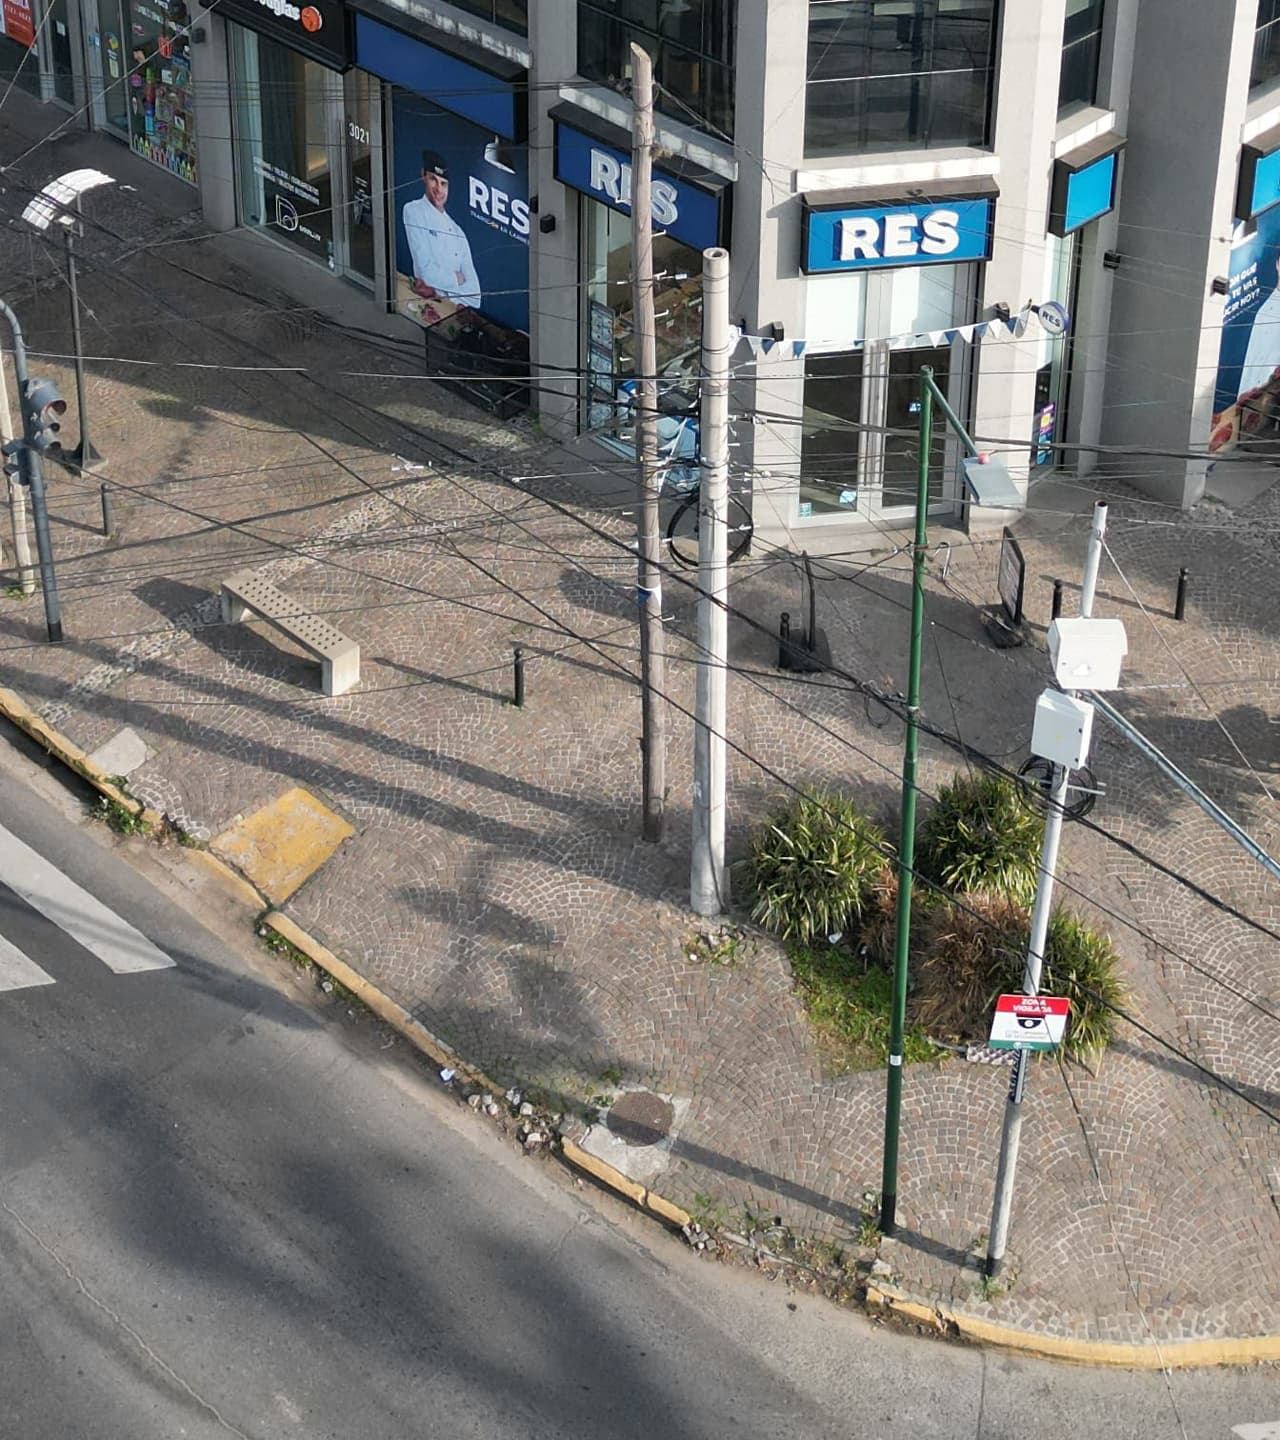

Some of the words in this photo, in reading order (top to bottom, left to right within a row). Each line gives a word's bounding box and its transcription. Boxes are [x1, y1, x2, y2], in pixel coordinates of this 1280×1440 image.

[349, 122, 369, 145] 3021
[469, 175, 530, 235] RES
[840, 210, 960, 261] RES
[1042, 310, 1061, 327] RES
